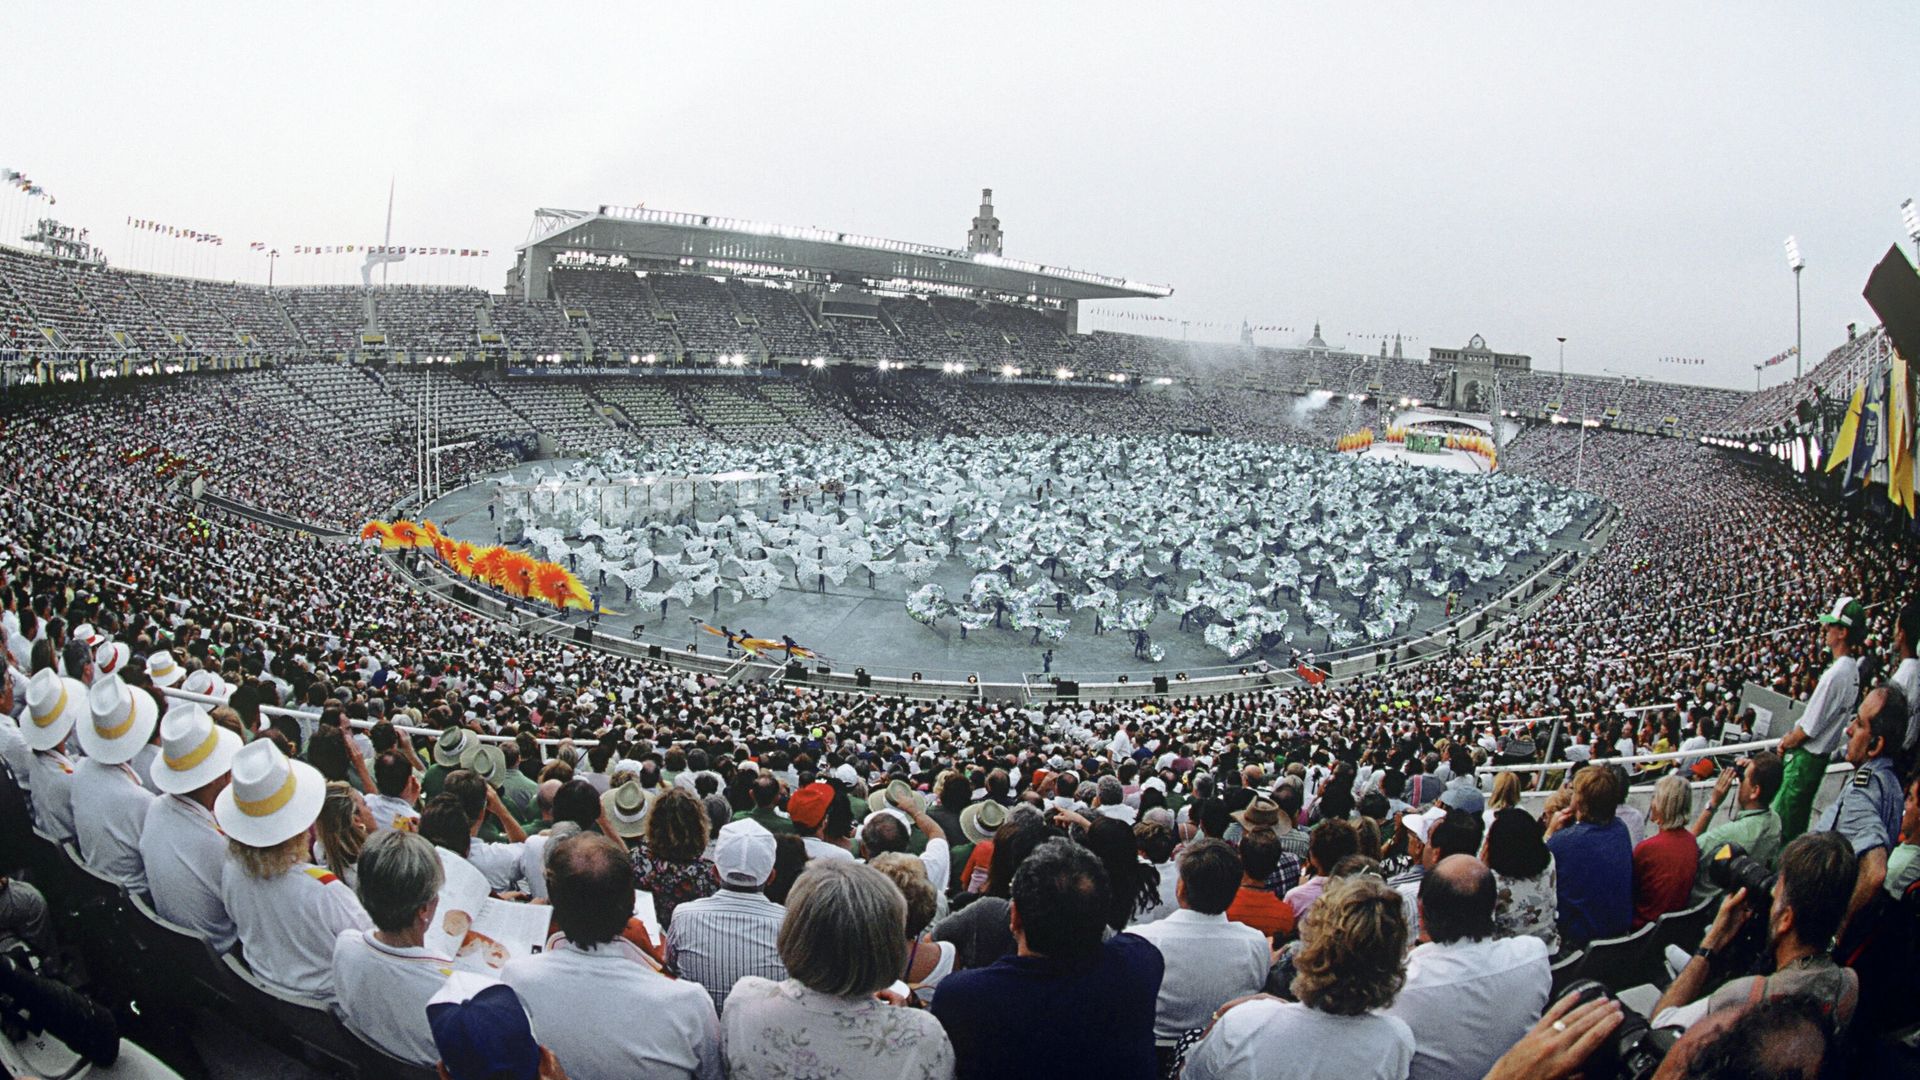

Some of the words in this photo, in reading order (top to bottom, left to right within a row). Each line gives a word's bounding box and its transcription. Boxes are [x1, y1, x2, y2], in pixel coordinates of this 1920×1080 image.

[563, 367, 571, 375] de
[573, 367, 580, 375] la
[665, 367, 686, 376] Juegos
[687, 367, 696, 375] de
[703, 367, 716, 375] XXV
